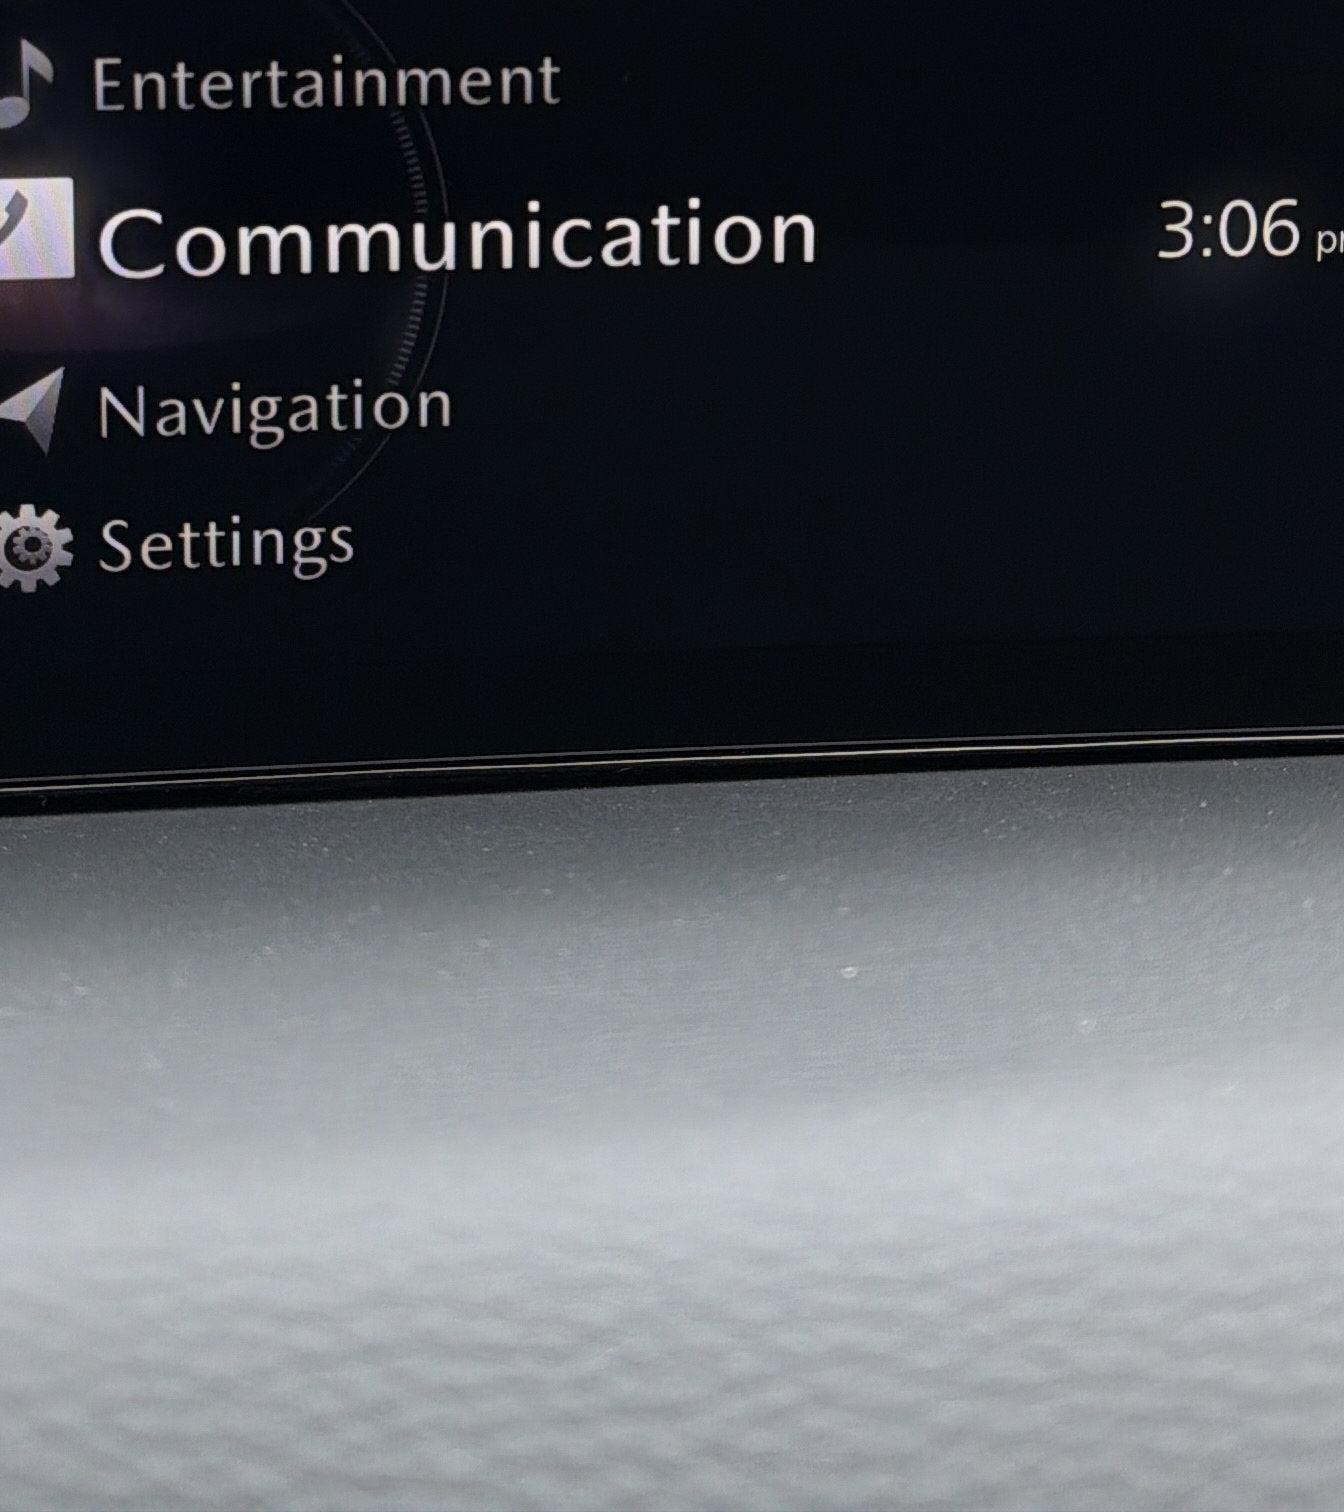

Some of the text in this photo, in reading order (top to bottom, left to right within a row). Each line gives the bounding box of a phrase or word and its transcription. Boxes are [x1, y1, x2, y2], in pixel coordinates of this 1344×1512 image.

[93, 53, 562, 113] Entertainment
[98, 196, 818, 281] Communication
[1157, 197, 1302, 260] 3:06
[99, 377, 452, 451] Navigation
[98, 513, 355, 581] Settings
